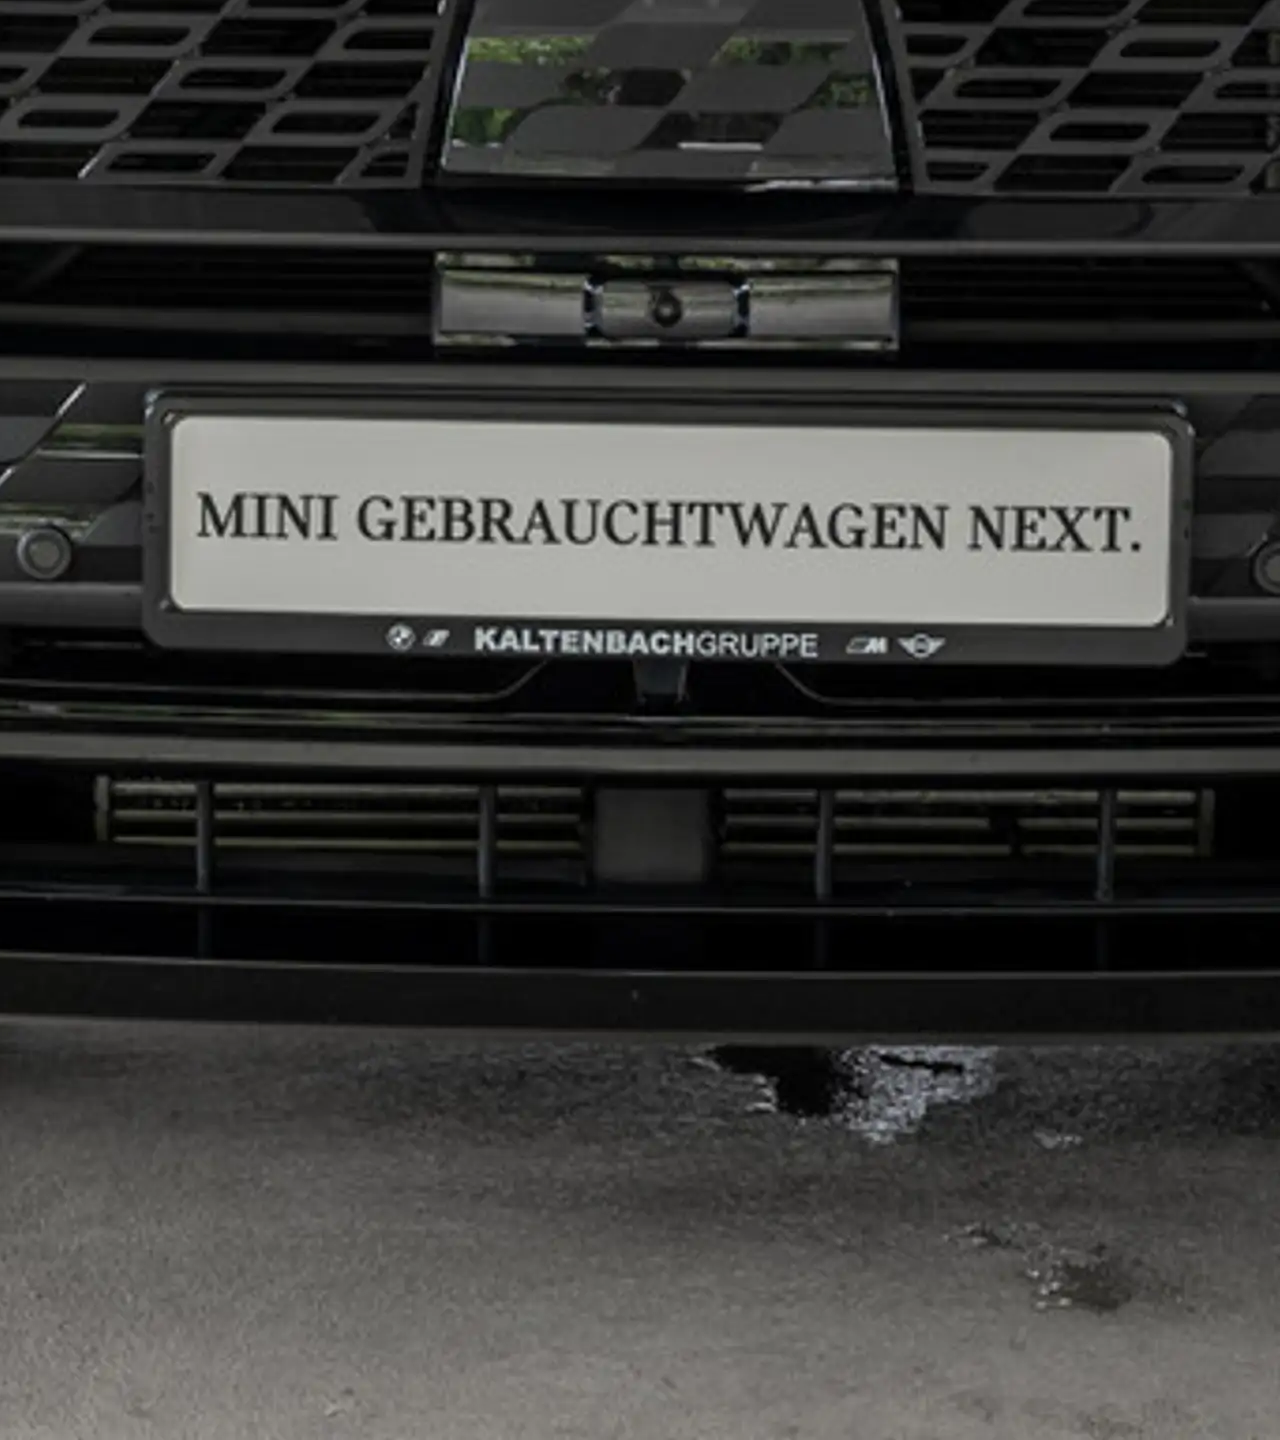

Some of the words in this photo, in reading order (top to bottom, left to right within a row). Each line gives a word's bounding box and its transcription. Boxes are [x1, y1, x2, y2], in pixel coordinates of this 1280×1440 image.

[197, 492, 339, 541] MINI
[357, 494, 950, 550] GEBRAUCHTWAGEN
[968, 504, 1141, 553] NEXT.
[474, 626, 819, 658] KALTENBACHGRUPPE
